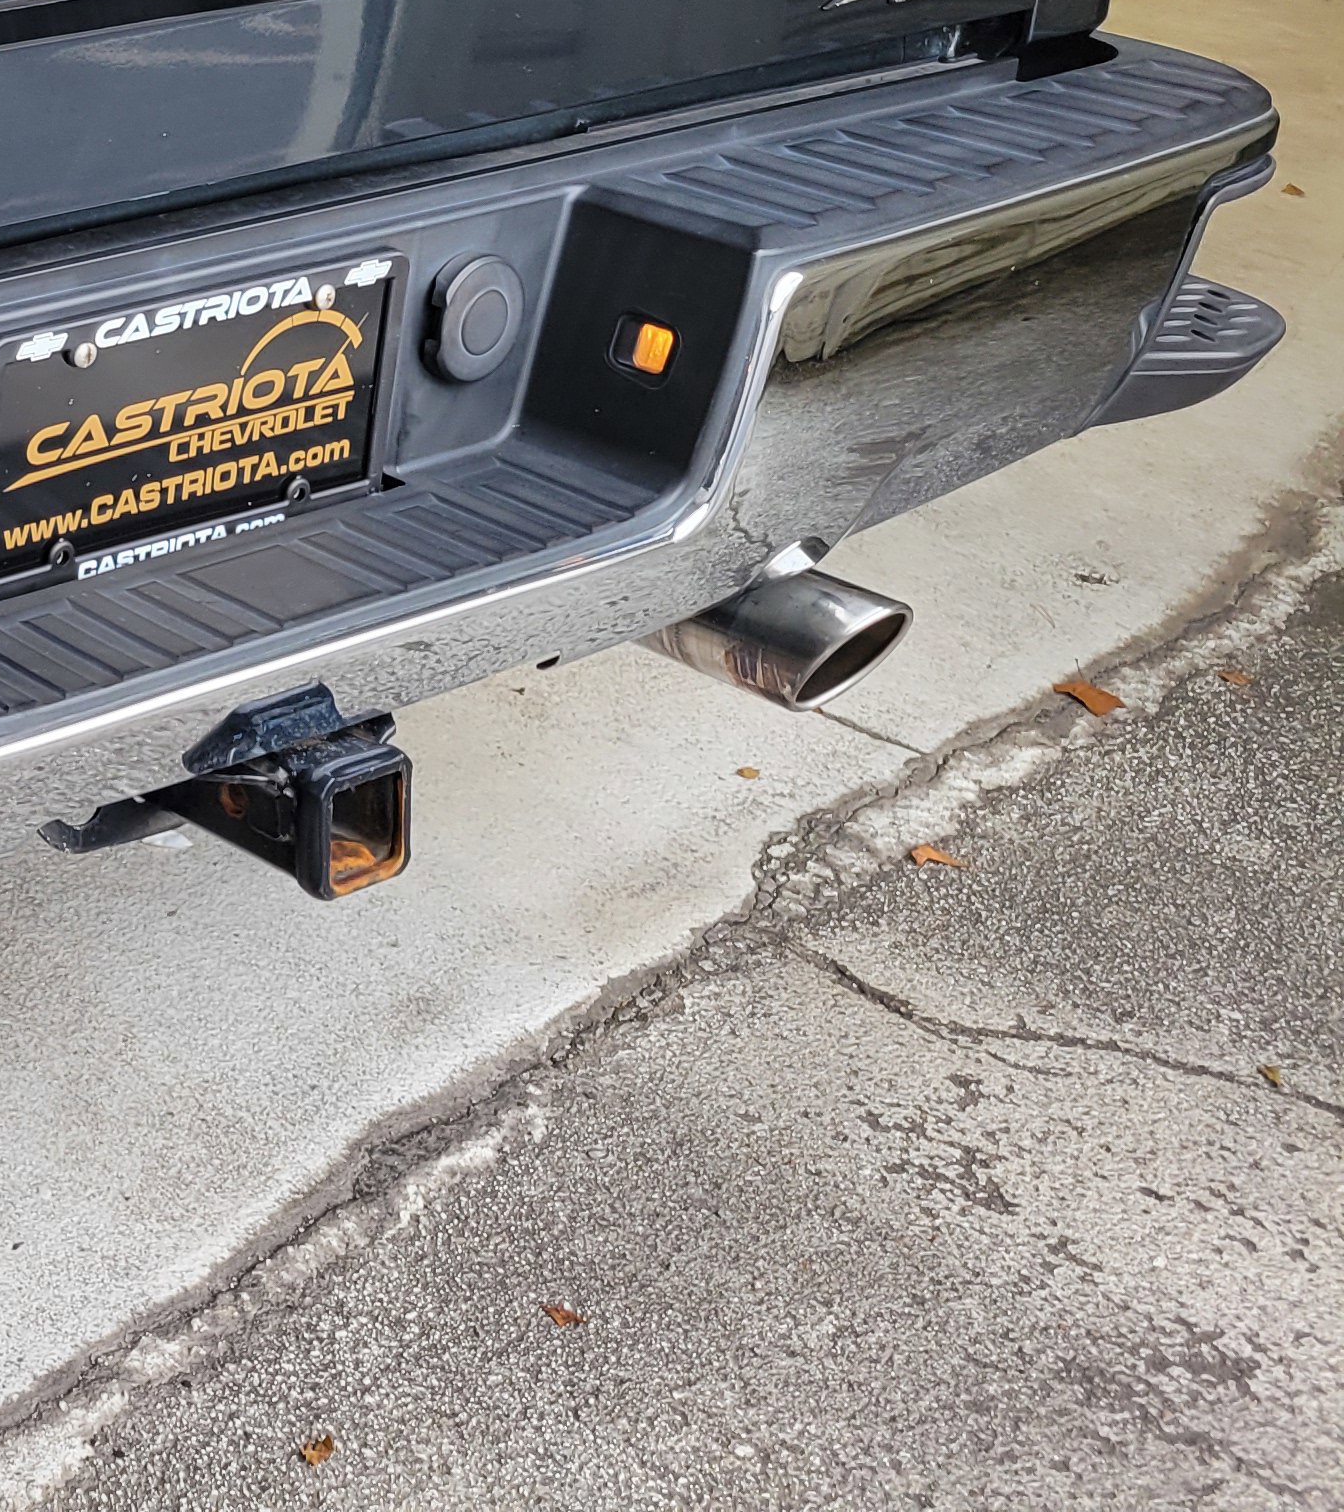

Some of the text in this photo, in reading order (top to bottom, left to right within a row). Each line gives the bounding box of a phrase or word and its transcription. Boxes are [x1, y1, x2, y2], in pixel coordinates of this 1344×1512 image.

[94, 276, 313, 348] CASTRIOTA
[26, 353, 355, 466] CASTRIOTA
[168, 395, 354, 463] CHEVROLET
[3, 438, 351, 551] www.CASTRIOTA.com
